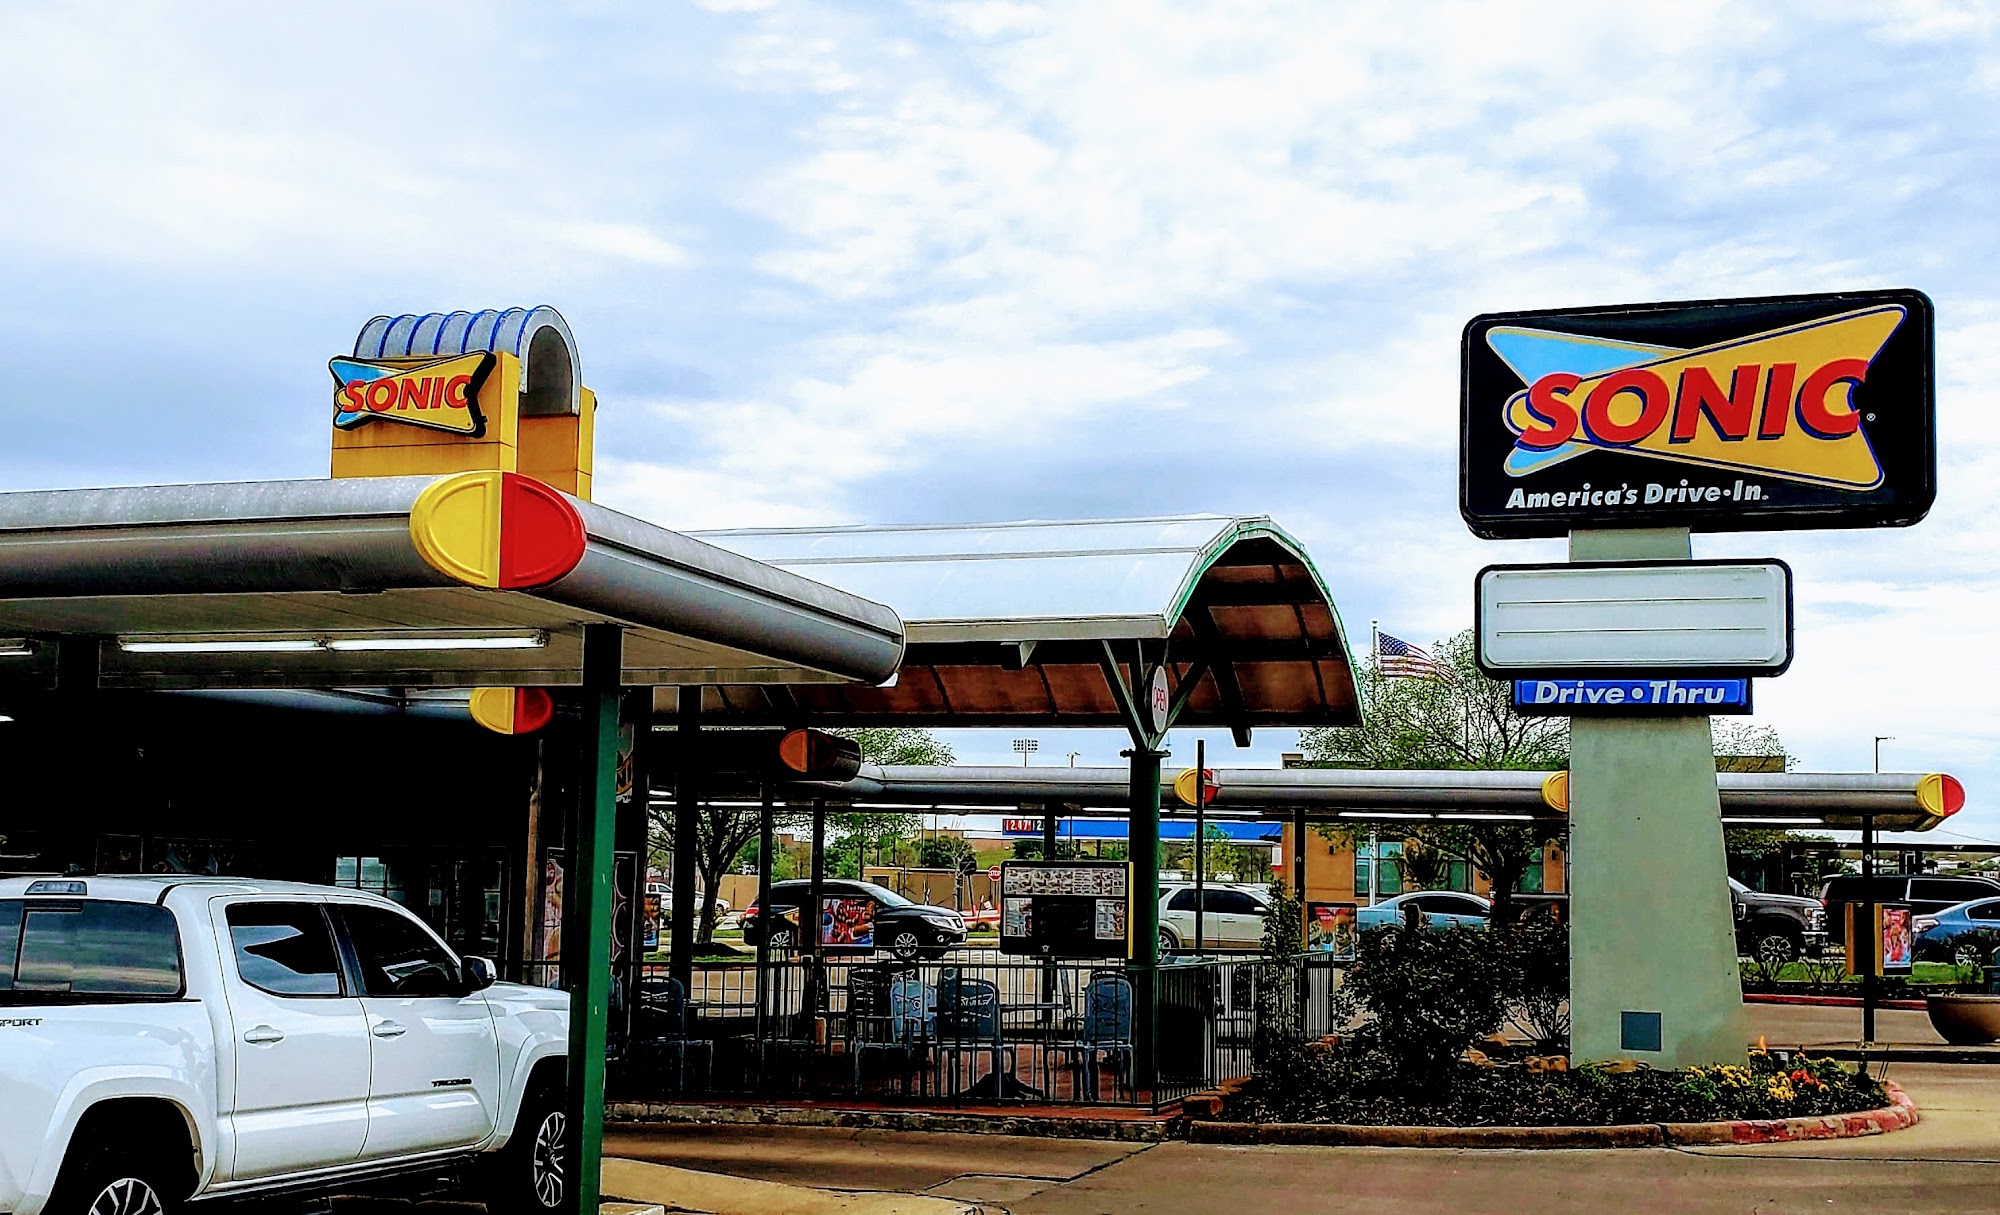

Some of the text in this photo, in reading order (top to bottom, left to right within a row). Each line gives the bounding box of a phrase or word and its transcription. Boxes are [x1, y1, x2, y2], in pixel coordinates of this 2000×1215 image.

[340, 374, 472, 414] SONIC
[1513, 357, 1870, 452] SONIC
[1505, 482, 1639, 508] America's
[1534, 679, 1726, 704] Drive Thru
[0, 1018, 43, 1026] PORT
